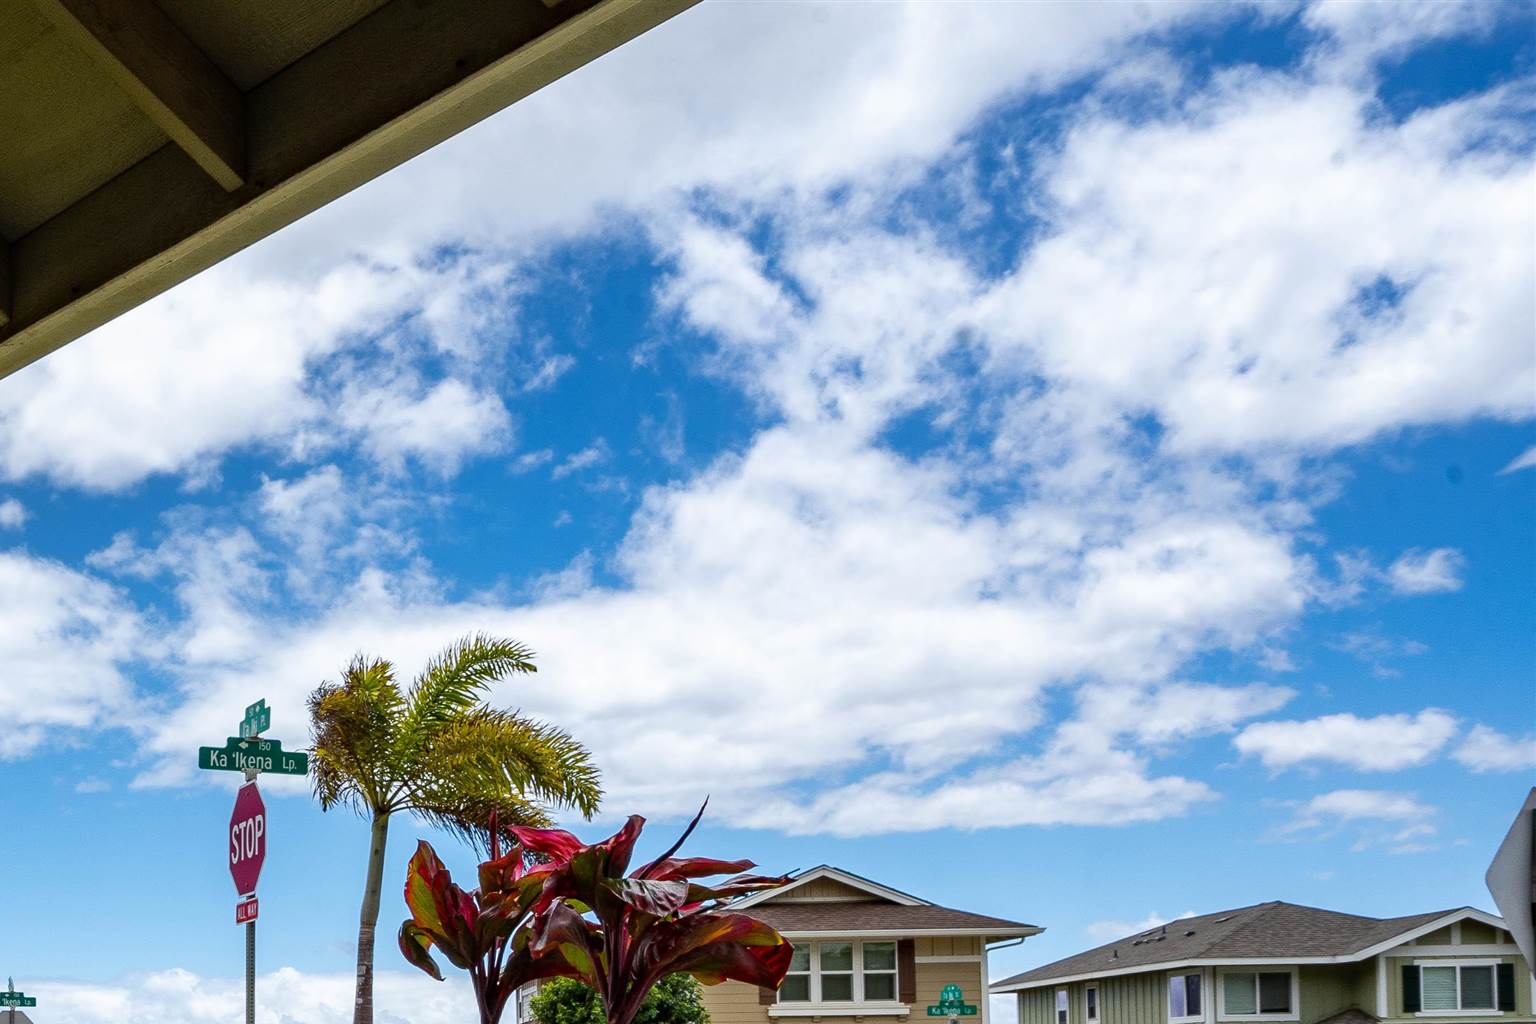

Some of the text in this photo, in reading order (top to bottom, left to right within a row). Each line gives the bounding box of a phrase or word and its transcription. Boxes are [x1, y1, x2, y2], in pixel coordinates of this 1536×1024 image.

[258, 742, 271, 751] 150
[210, 750, 227, 767] Ka
[282, 756, 297, 772] Lp.
[231, 814, 264, 865] STOP
[238, 902, 257, 920] ALL WAY
